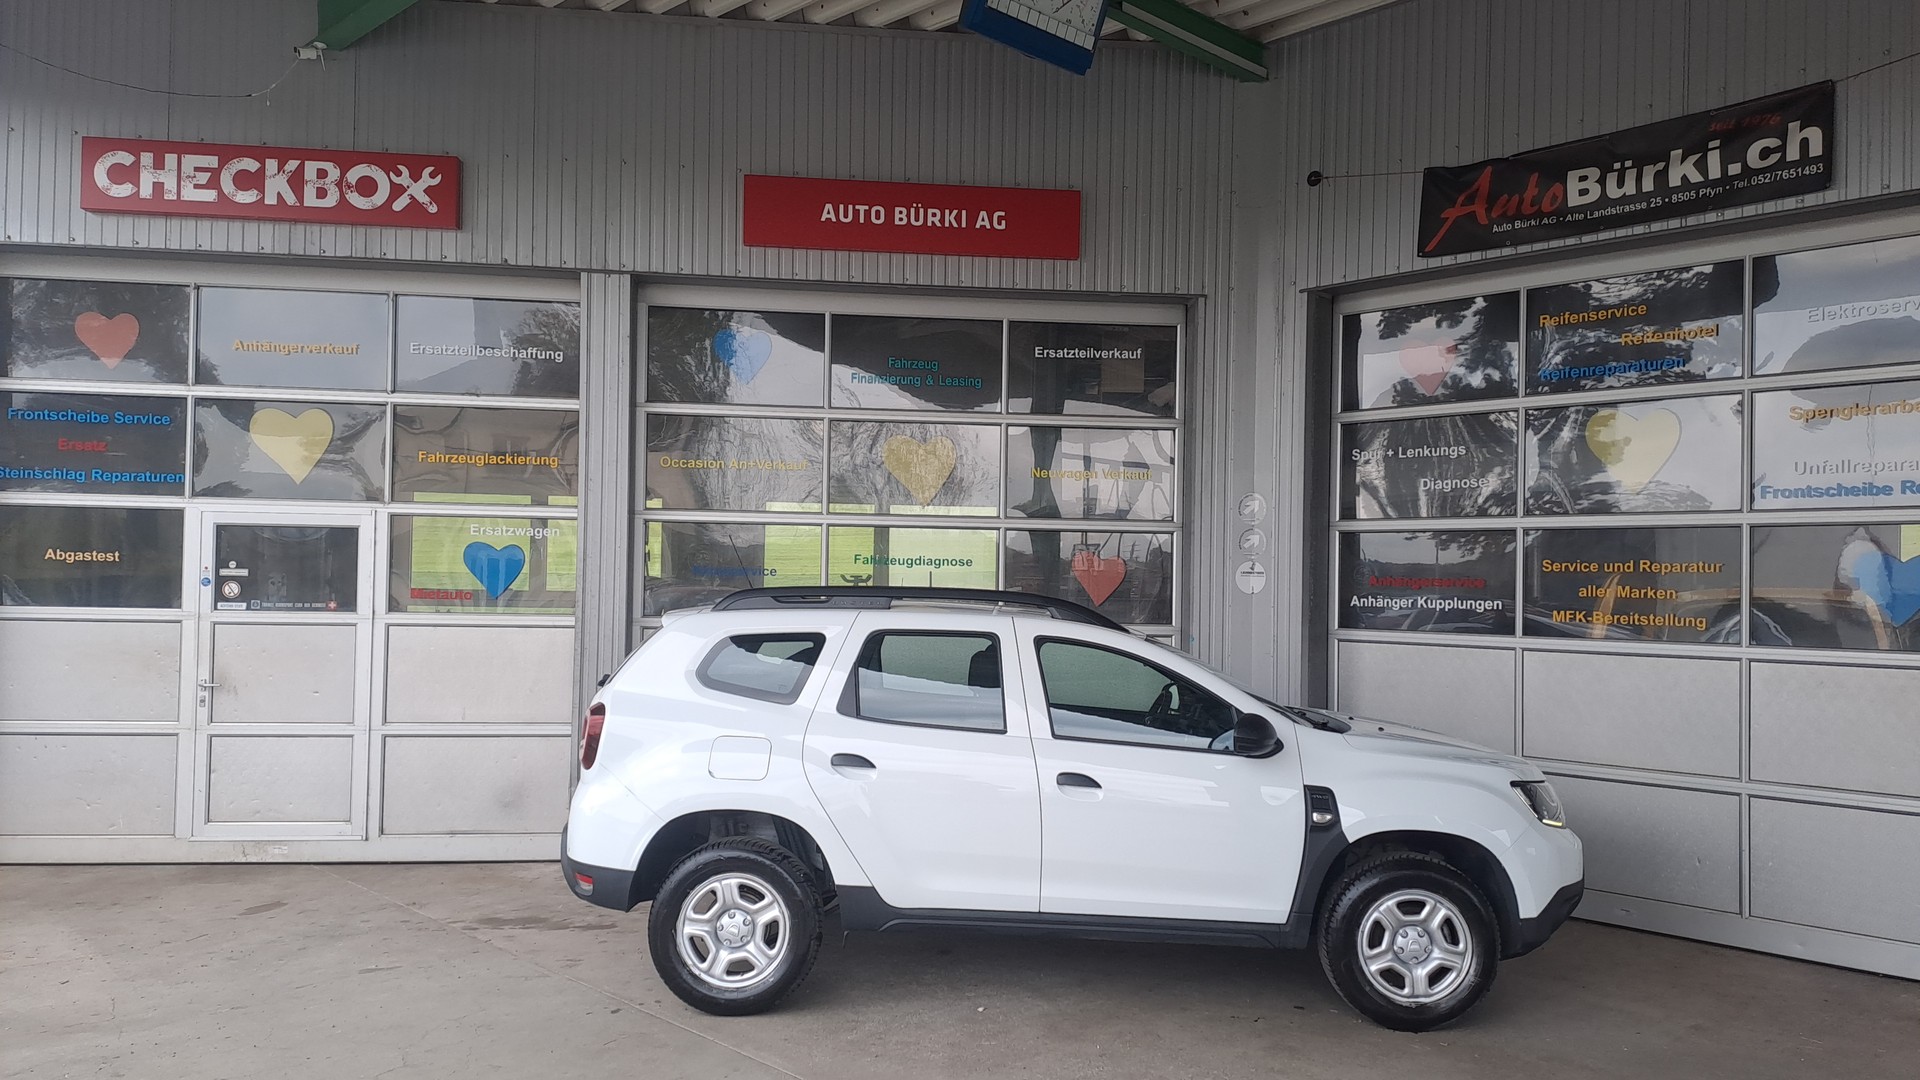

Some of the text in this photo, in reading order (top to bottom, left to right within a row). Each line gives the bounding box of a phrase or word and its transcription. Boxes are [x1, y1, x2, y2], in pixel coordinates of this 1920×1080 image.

[93, 150, 442, 214] CHECKBOX
[820, 203, 1006, 230] AUTO BÜRKI AG
[1492, 222, 1513, 233] Auto
[1514, 218, 1540, 230] Bürki
[1541, 215, 1557, 226] AG
[1565, 212, 1585, 223] Alte
[1586, 201, 1648, 220] Landstrasse
[1650, 197, 1663, 208] 25
[1671, 190, 1697, 204] 8505
[1699, 184, 1723, 200] Pfyn
[1539, 304, 1648, 328] Reifenservice
[1621, 323, 1720, 347] Reifenhotel
[232, 339, 361, 356] Anhängerverkauf
[409, 342, 565, 363] Ersatzteilbeschaffung
[1034, 346, 1143, 360] Ersatzteilverkauf
[887, 356, 939, 372] Fahrzeug
[1540, 357, 1686, 382] Reifenreparaturen
[850, 372, 982, 389] Finanzierung & Leasing
[7, 406, 171, 426] Frontscheibe Service
[57, 437, 109, 452] Ersatz
[418, 450, 559, 468] Fahrzeuglackierung
[1351, 448, 1383, 463] Spur
[1398, 444, 1467, 459] Lenkungs
[659, 456, 725, 470] Occasion
[0, 465, 185, 484] Steinschlag Reparaturen
[1031, 466, 1153, 482] Neuwagen Verkauf
[1420, 477, 1487, 492] Diagnose
[1760, 481, 1894, 500] Frontscheibe
[470, 523, 560, 539] Ersatzwagen
[44, 548, 120, 564] Abgastest
[853, 553, 974, 569] Fahrzeugdiagnose
[1541, 559, 1724, 576] Service und Reparatur
[1367, 575, 1487, 591] Anhängerservice
[1578, 585, 1678, 600] aller Marken
[1350, 594, 1504, 613] Anhänger Kupplungen
[1552, 609, 1708, 632] MFK-Bereitstellung
